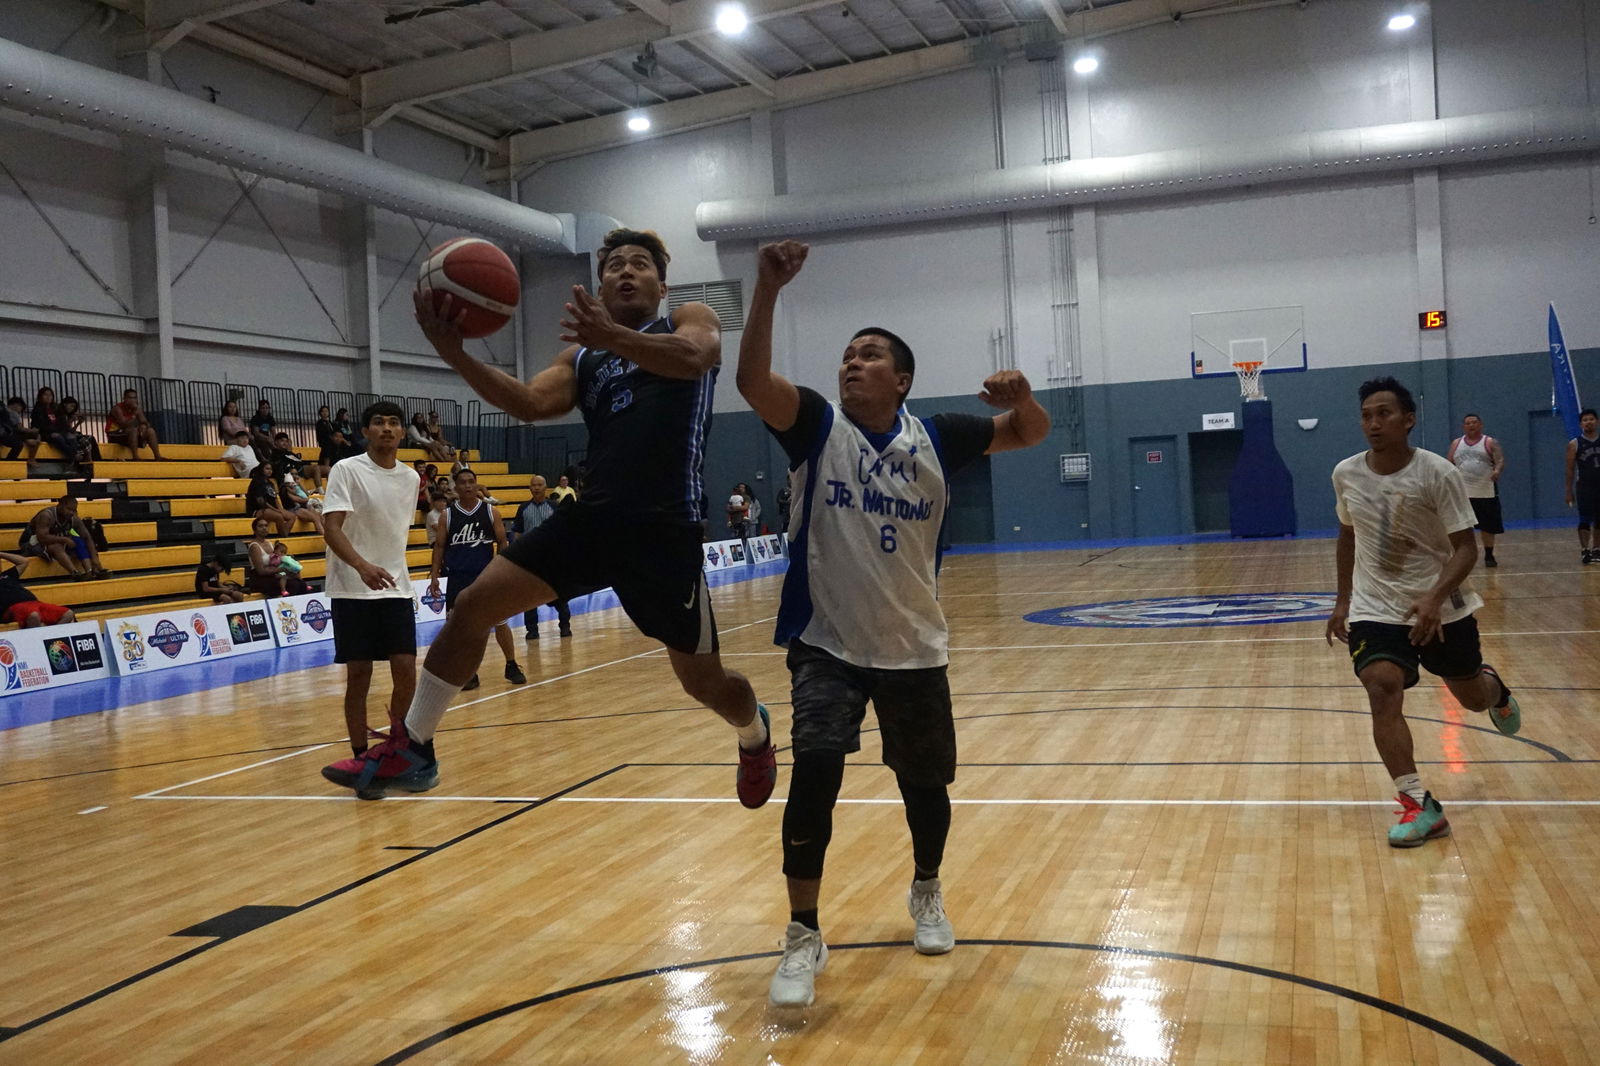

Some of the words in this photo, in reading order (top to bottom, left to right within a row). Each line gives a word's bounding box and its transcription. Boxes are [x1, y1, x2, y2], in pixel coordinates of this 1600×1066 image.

[1427, 311, 1440, 327] 15
[825, 479, 855, 508] JR.
[880, 524, 897, 554] 6
[249, 614, 264, 625] FIBA
[170, 633, 188, 642] ULTRA
[76, 638, 95, 652] FIBA
[20, 667, 48, 679] BASKETBALL
[22, 675, 49, 688] FEDERATION
